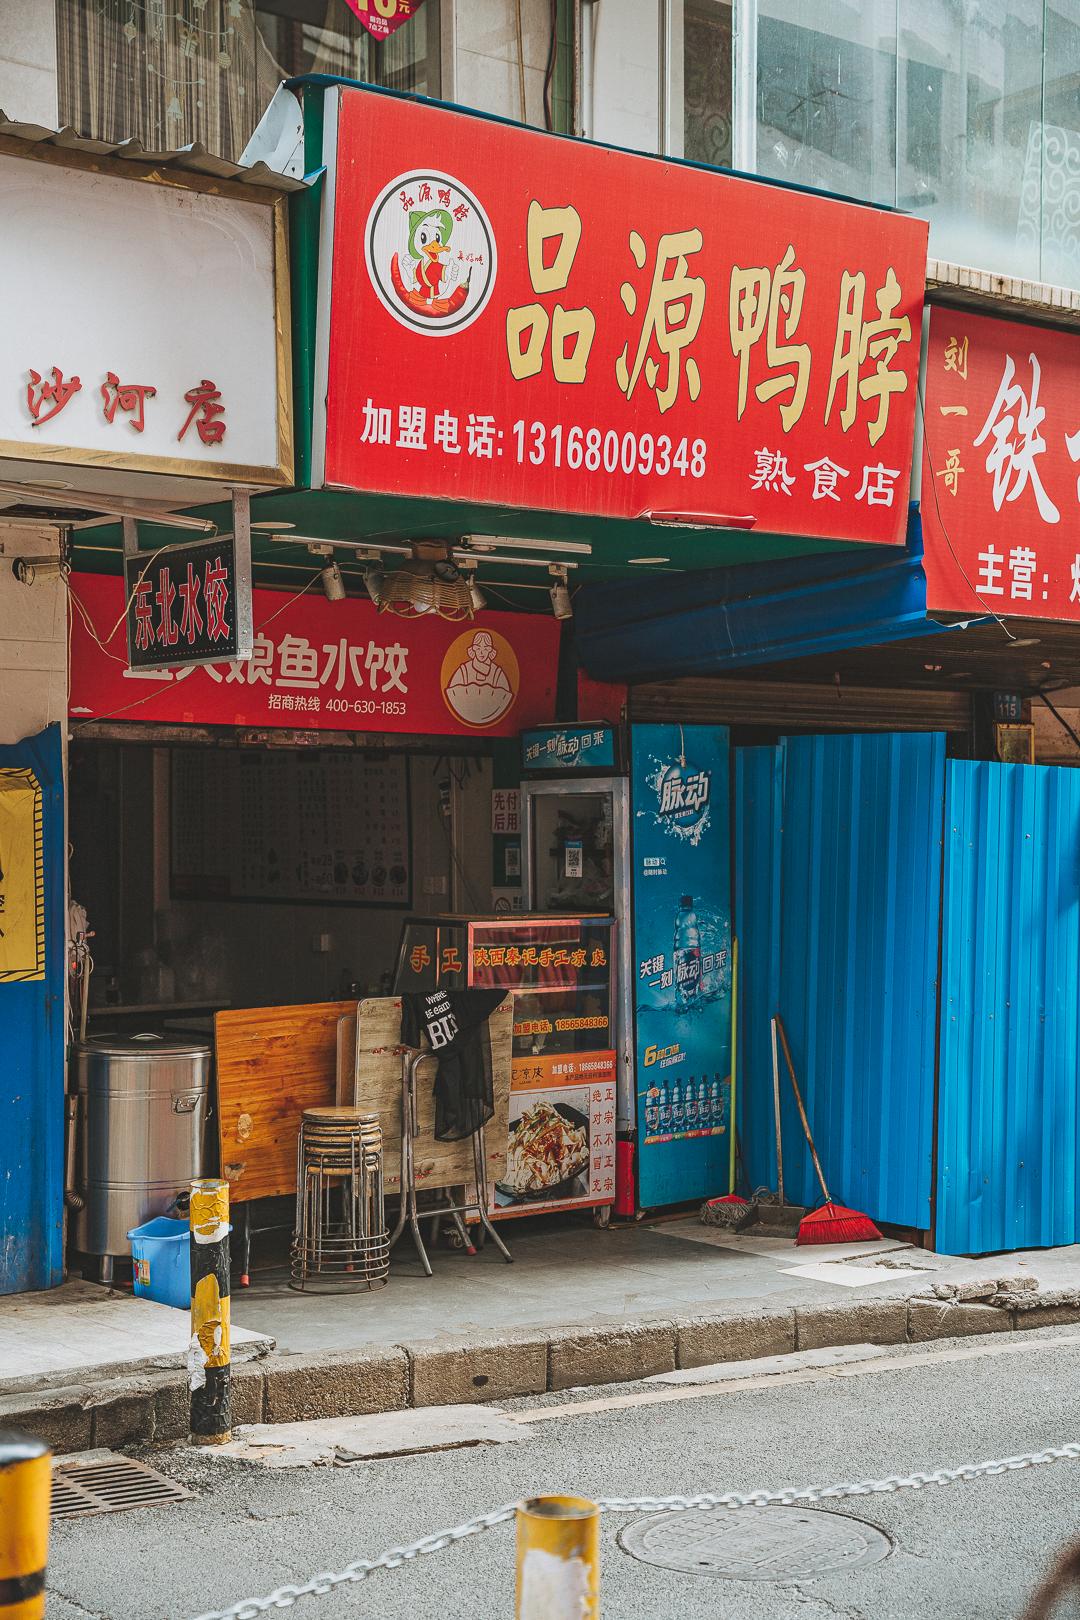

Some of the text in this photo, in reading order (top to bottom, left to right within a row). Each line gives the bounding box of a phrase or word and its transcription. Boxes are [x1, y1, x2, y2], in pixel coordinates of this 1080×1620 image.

[506, 199, 913, 447] 品源鸭脖
[26, 366, 228, 447] 沙河店
[936, 336, 969, 497] 刘一哥
[513, 418, 708, 479] 13168009348
[973, 351, 1080, 525] 铁
[749, 446, 901, 508] 熟食店
[132, 556, 231, 652] 东北水饺
[267, 693, 407, 717] 招商热线 400-630-1853
[999, 703, 1017, 717] 115
[493, 791, 518, 811] 先付
[493, 813, 518, 832] 后用
[659, 770, 710, 814] 脉动
[409, 944, 463, 974] 手工
